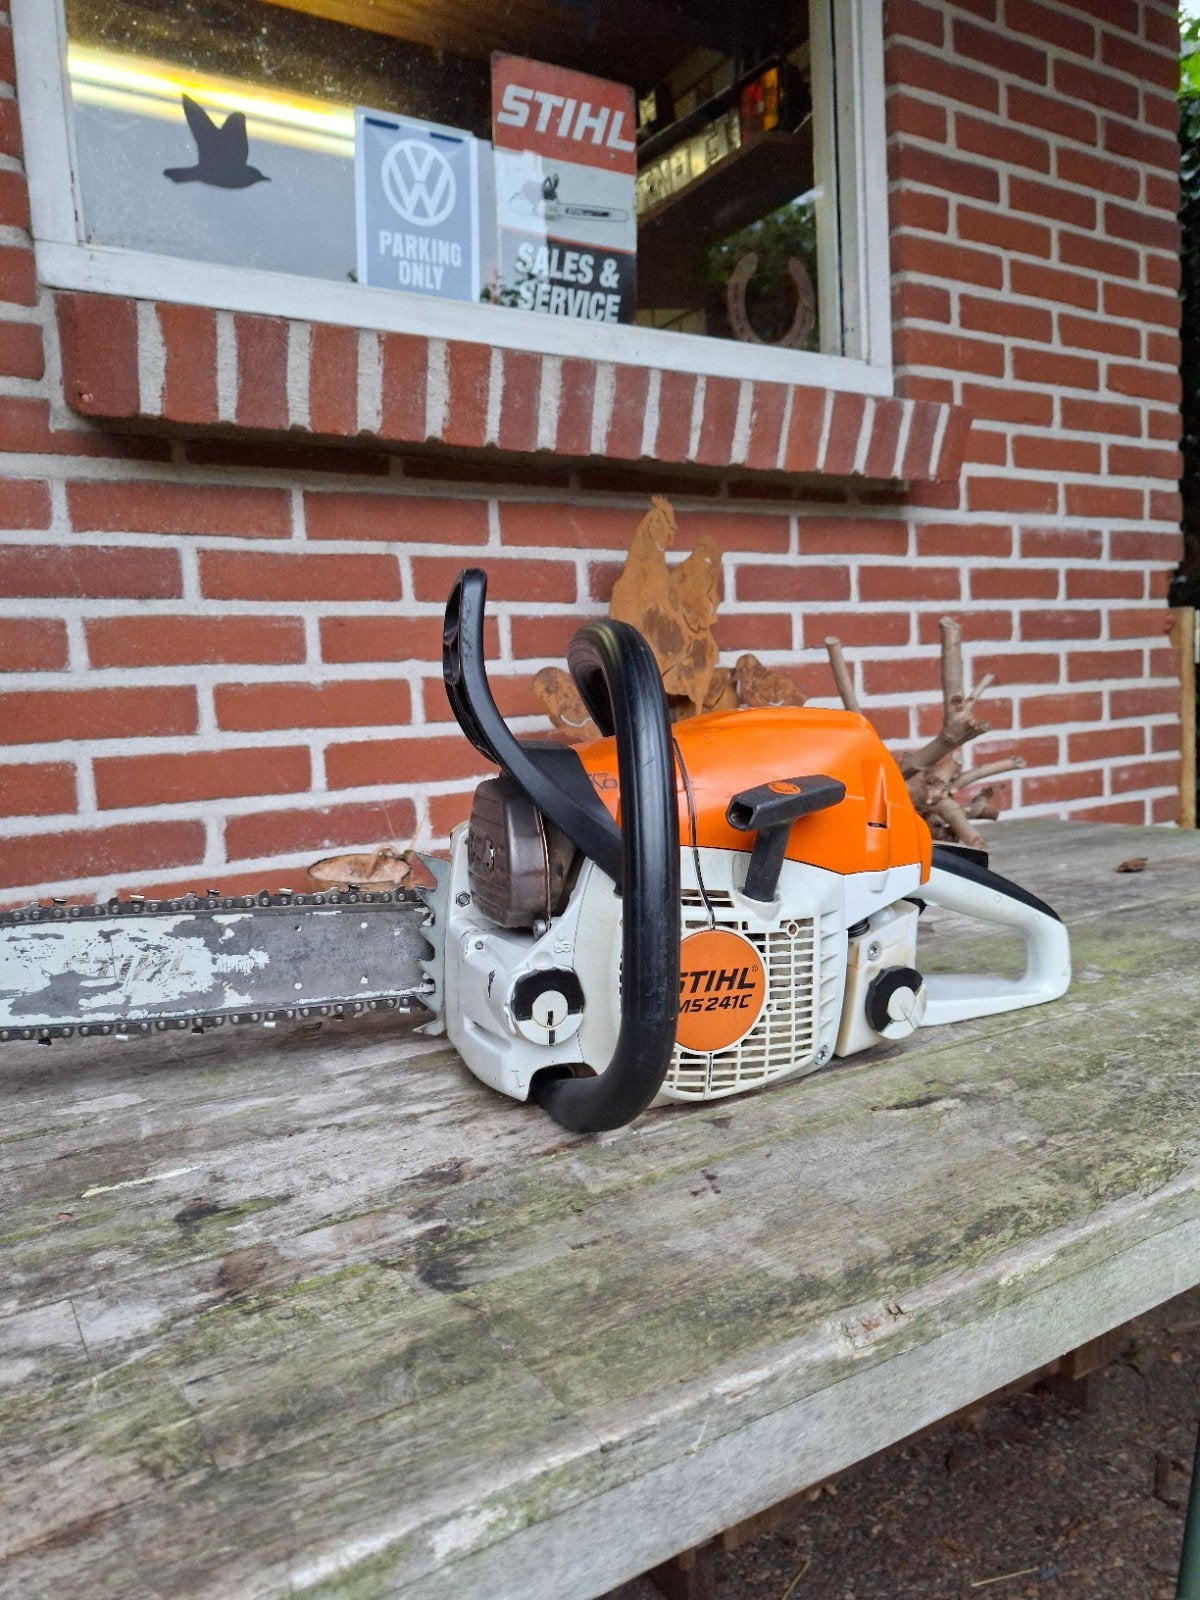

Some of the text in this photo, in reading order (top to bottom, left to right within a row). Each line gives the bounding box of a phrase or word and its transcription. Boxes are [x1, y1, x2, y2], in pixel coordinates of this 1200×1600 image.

[498, 84, 635, 152] STIHL
[379, 230, 462, 268] PARKING
[516, 242, 620, 289] SALES &
[399, 260, 444, 291] ONLY
[518, 280, 622, 323] SERVICE
